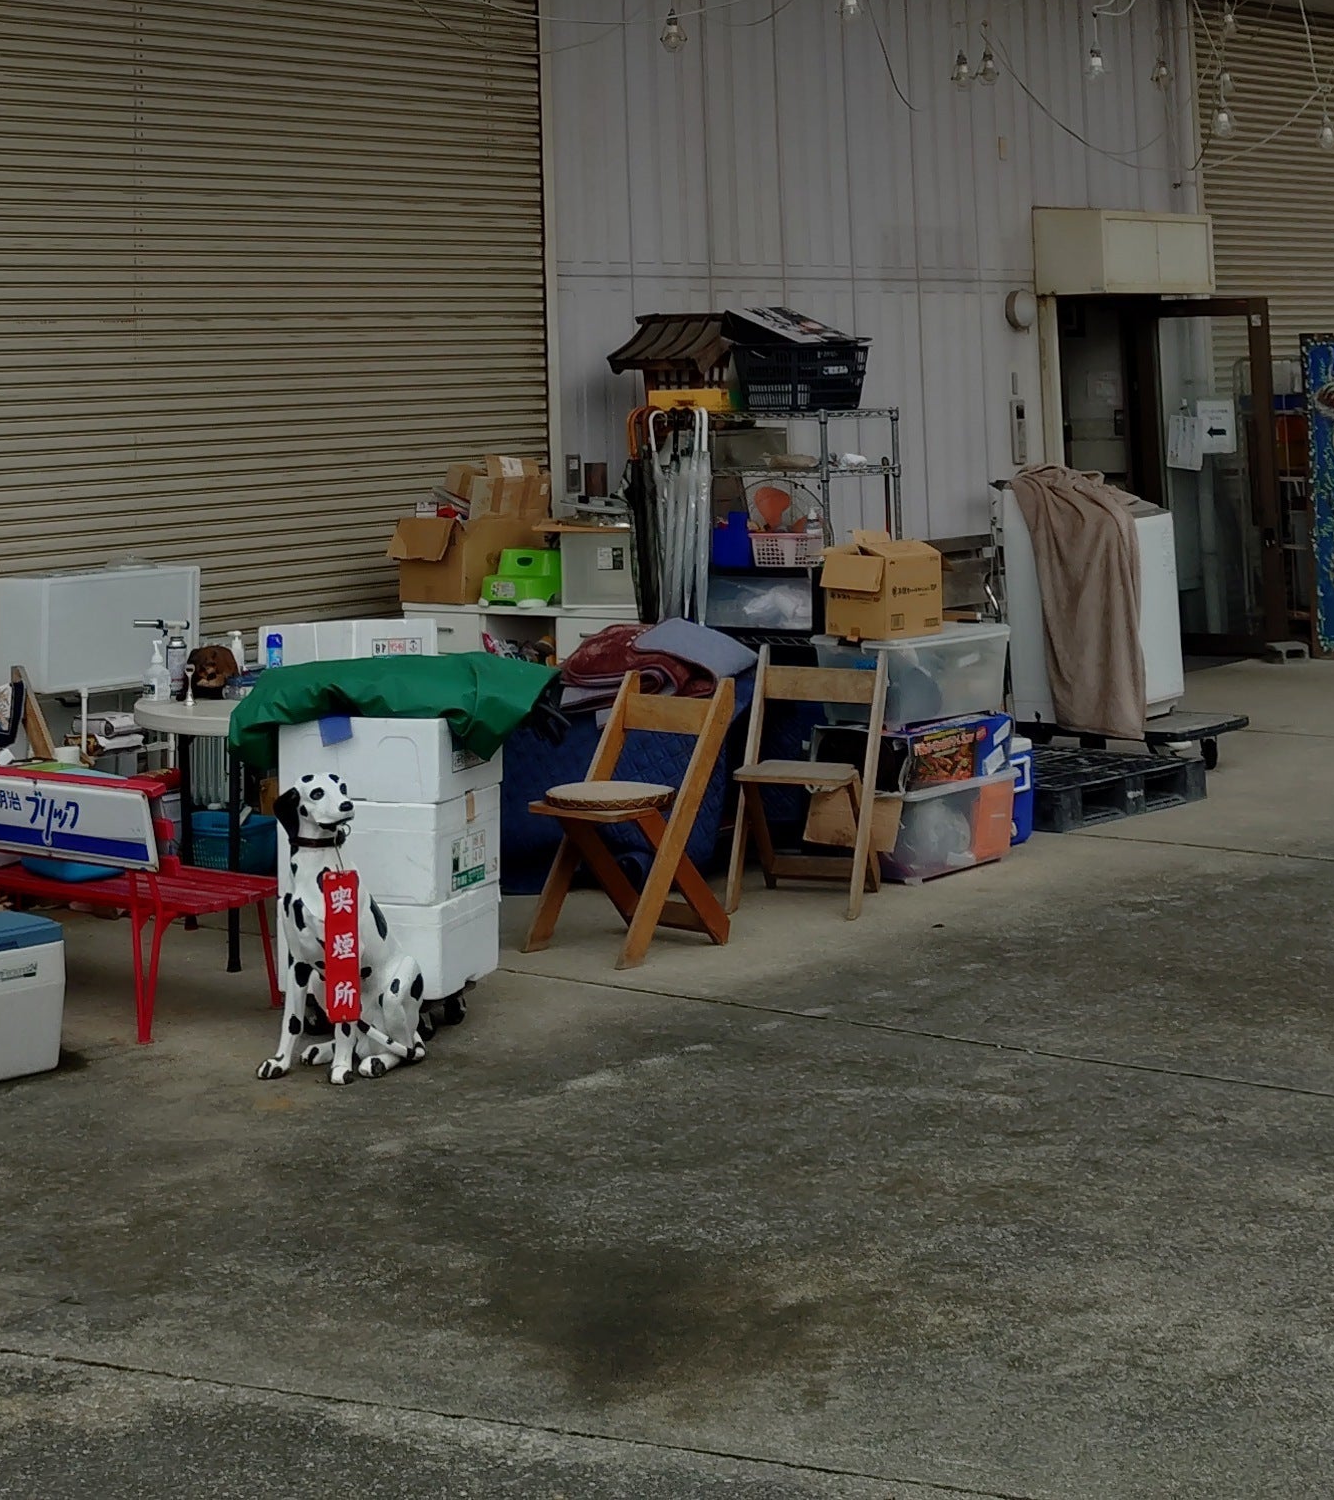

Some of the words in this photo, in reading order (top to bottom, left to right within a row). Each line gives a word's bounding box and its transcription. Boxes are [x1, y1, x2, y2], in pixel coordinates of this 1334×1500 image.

[25, 791, 80, 841] ブリック
[330, 885, 357, 1009] 喫煙所
